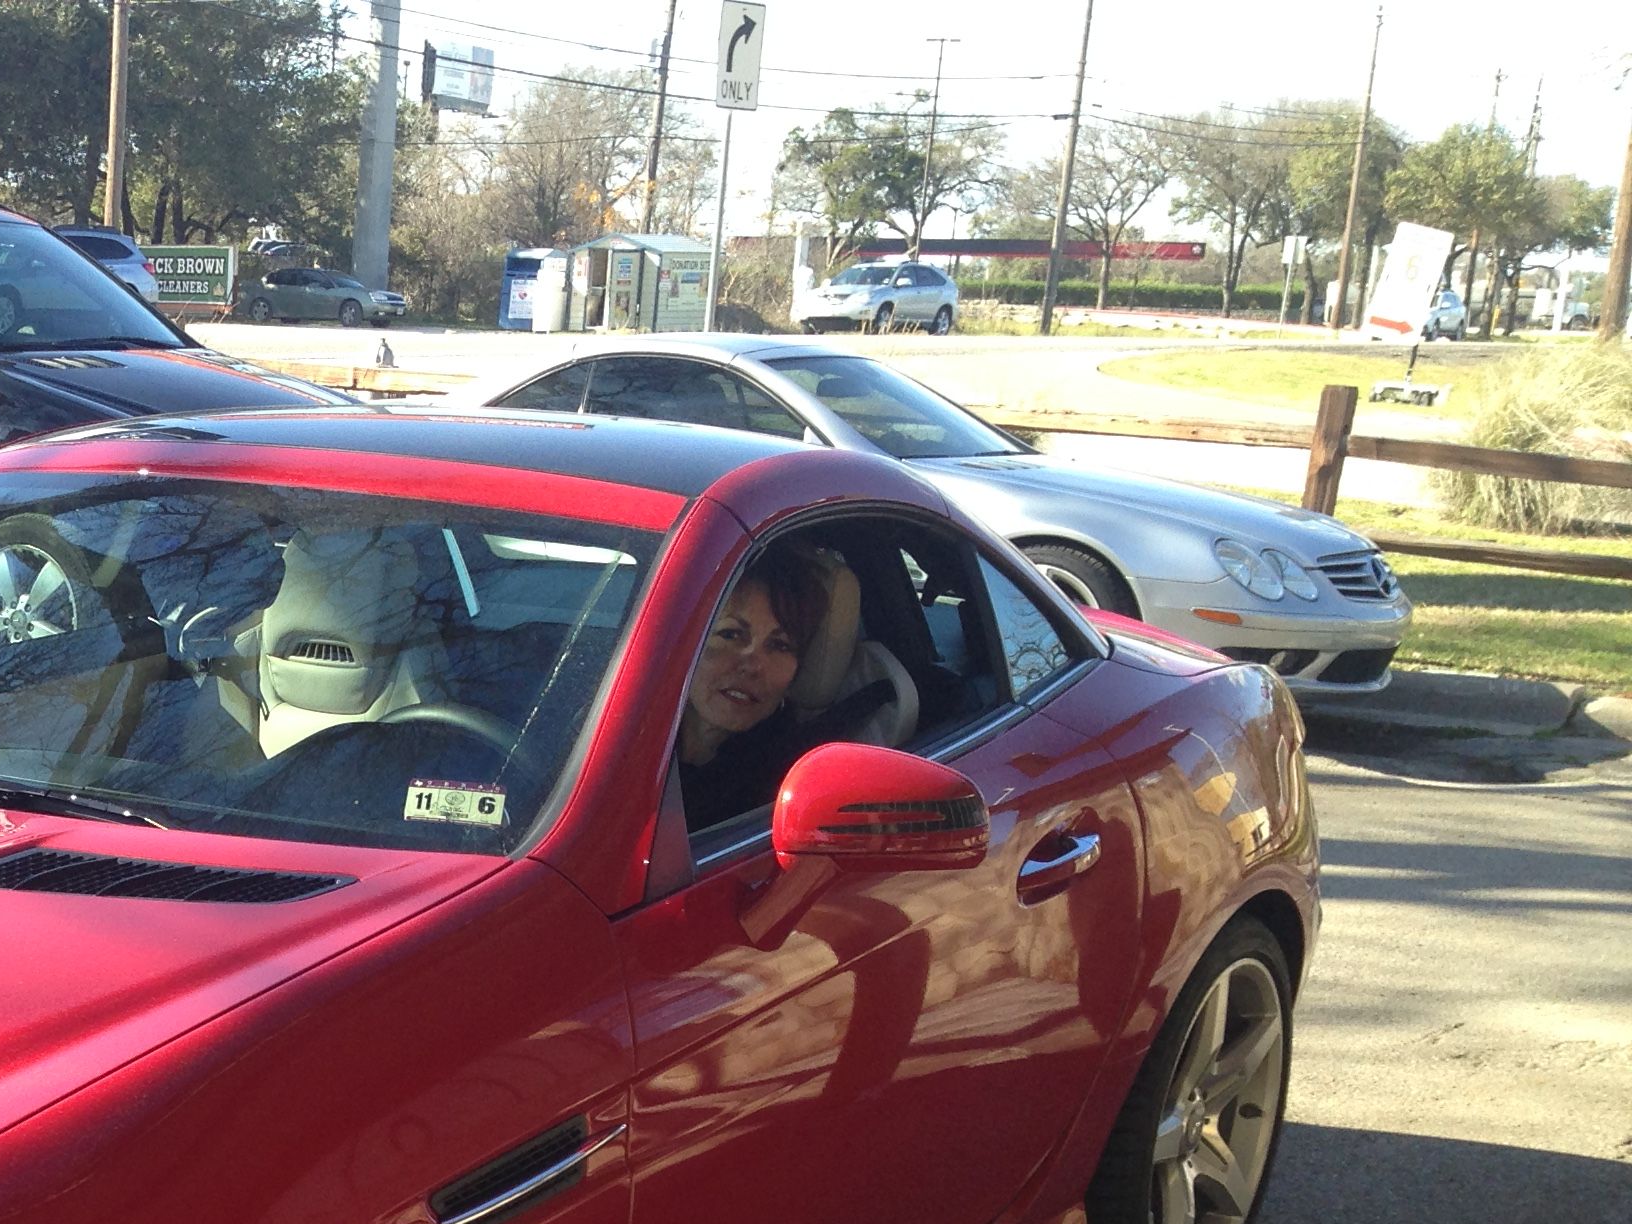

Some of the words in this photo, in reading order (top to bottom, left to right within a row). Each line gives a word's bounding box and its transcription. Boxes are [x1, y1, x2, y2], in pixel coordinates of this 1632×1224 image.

[721, 80, 753, 101] ONLY
[177, 258, 225, 274] BROWN
[158, 280, 209, 293] CLEANERS
[415, 792, 433, 811] 11
[478, 796, 497, 815] 6
